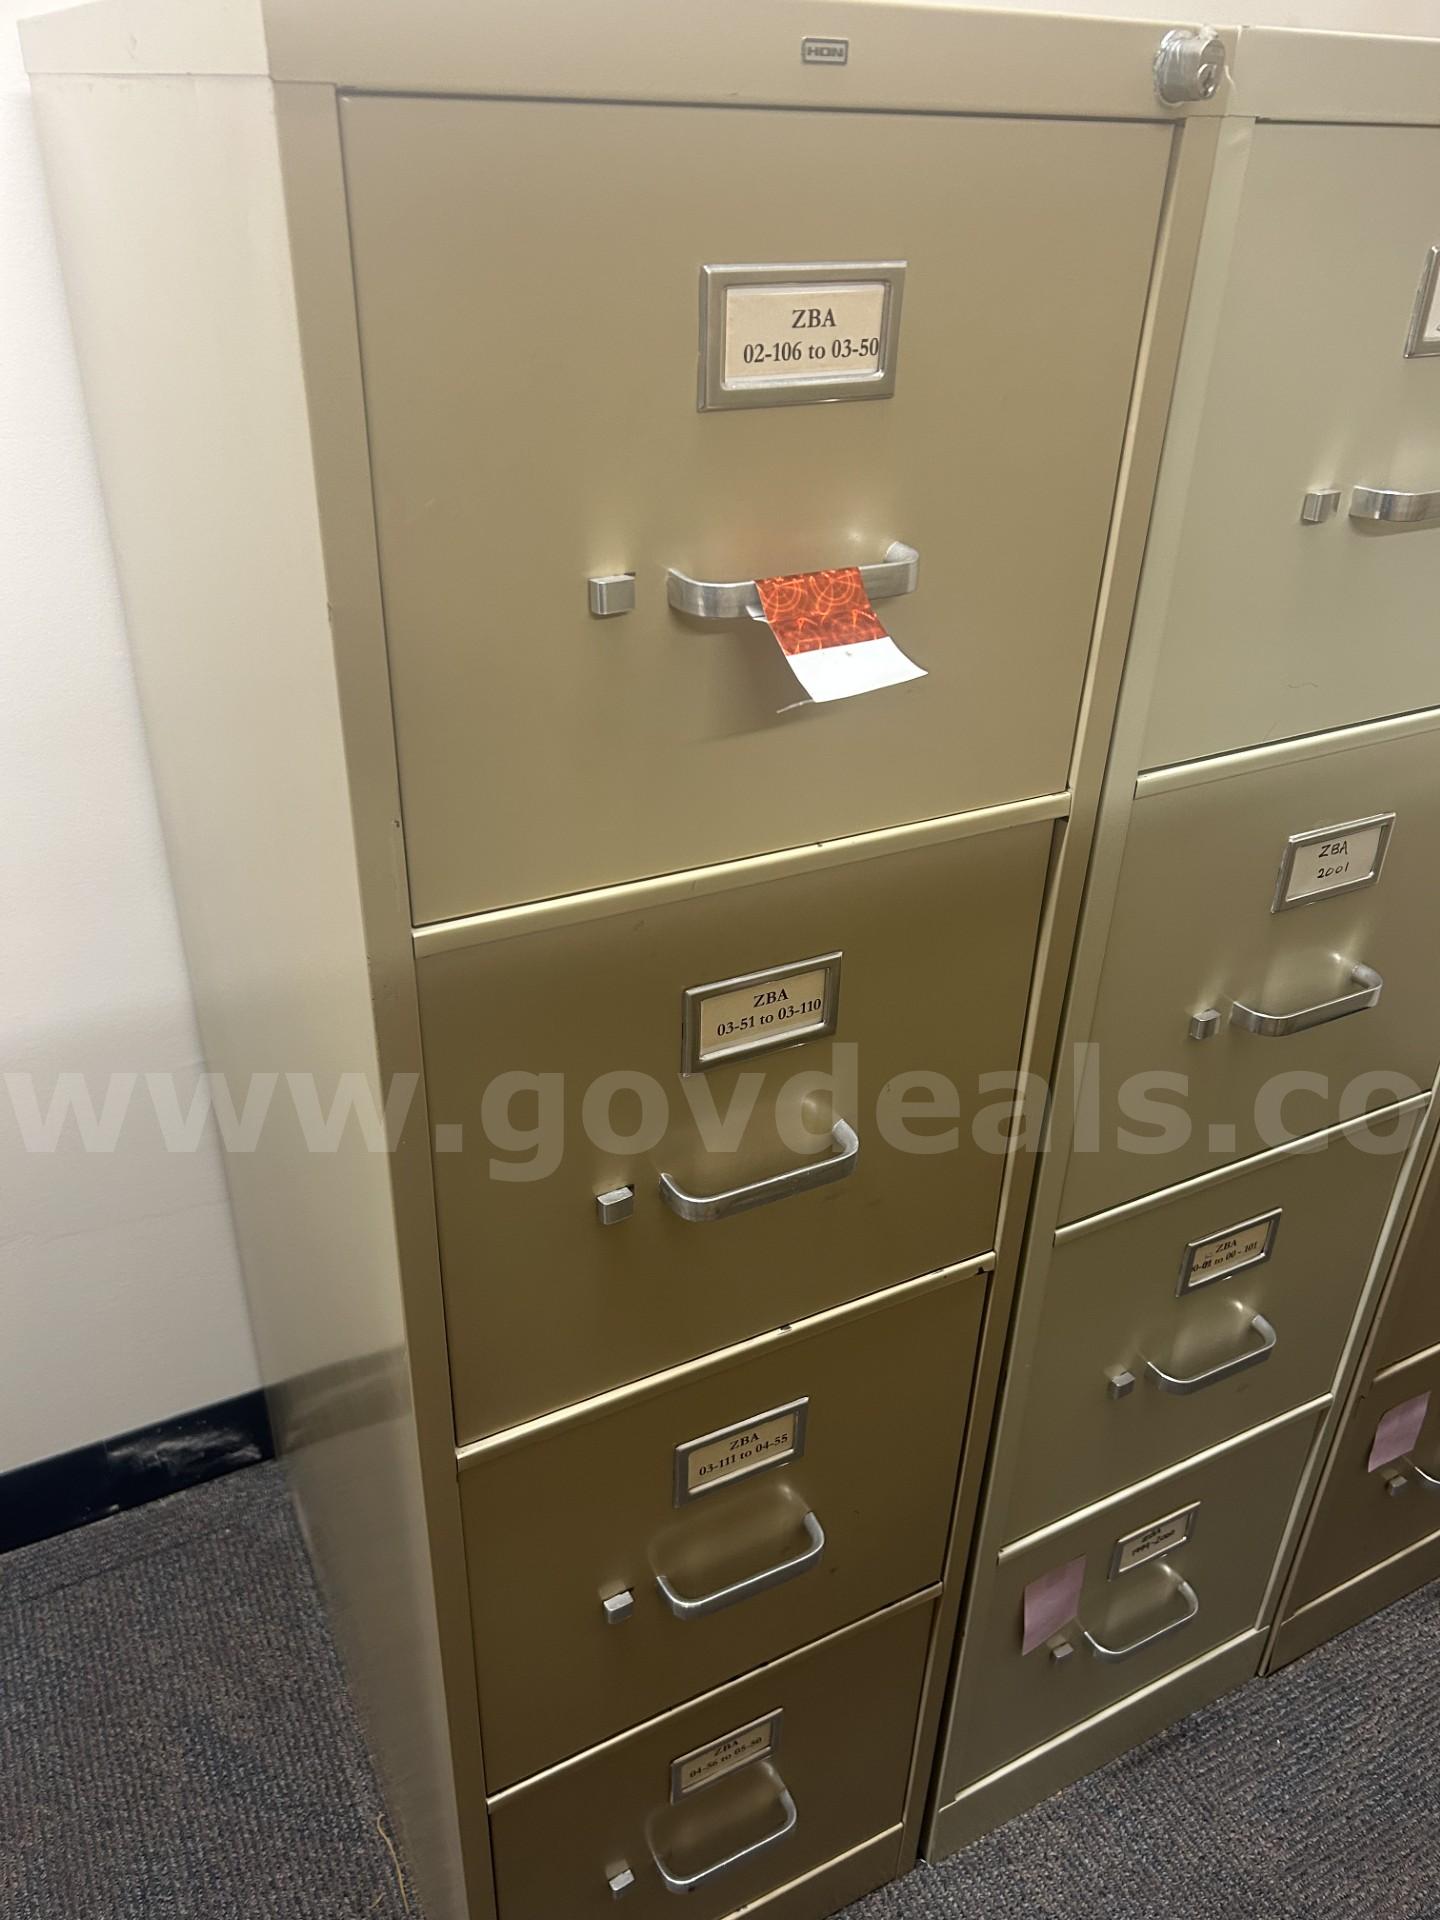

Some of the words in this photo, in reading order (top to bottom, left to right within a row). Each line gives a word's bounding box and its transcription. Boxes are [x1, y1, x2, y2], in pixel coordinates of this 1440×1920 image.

[807, 46, 844, 58] HON
[791, 308, 838, 329] ZBA
[743, 340, 803, 364] 02-106
[808, 341, 826, 361] to
[831, 337, 880, 359] 03-50
[1318, 840, 1349, 858] ZBA
[1316, 863, 1350, 879] 2001
[752, 988, 790, 1009] ZBA
[716, 1014, 755, 1037] 03-51
[759, 1012, 775, 1025] to
[777, 997, 822, 1021] 03-110
[1215, 1239, 1238, 1254] ZBA
[729, 1432, 761, 1451] ZBA
[698, 1453, 737, 1477] 03-111
[739, 1447, 753, 1461] to
[755, 1433, 788, 1454] 04-55
